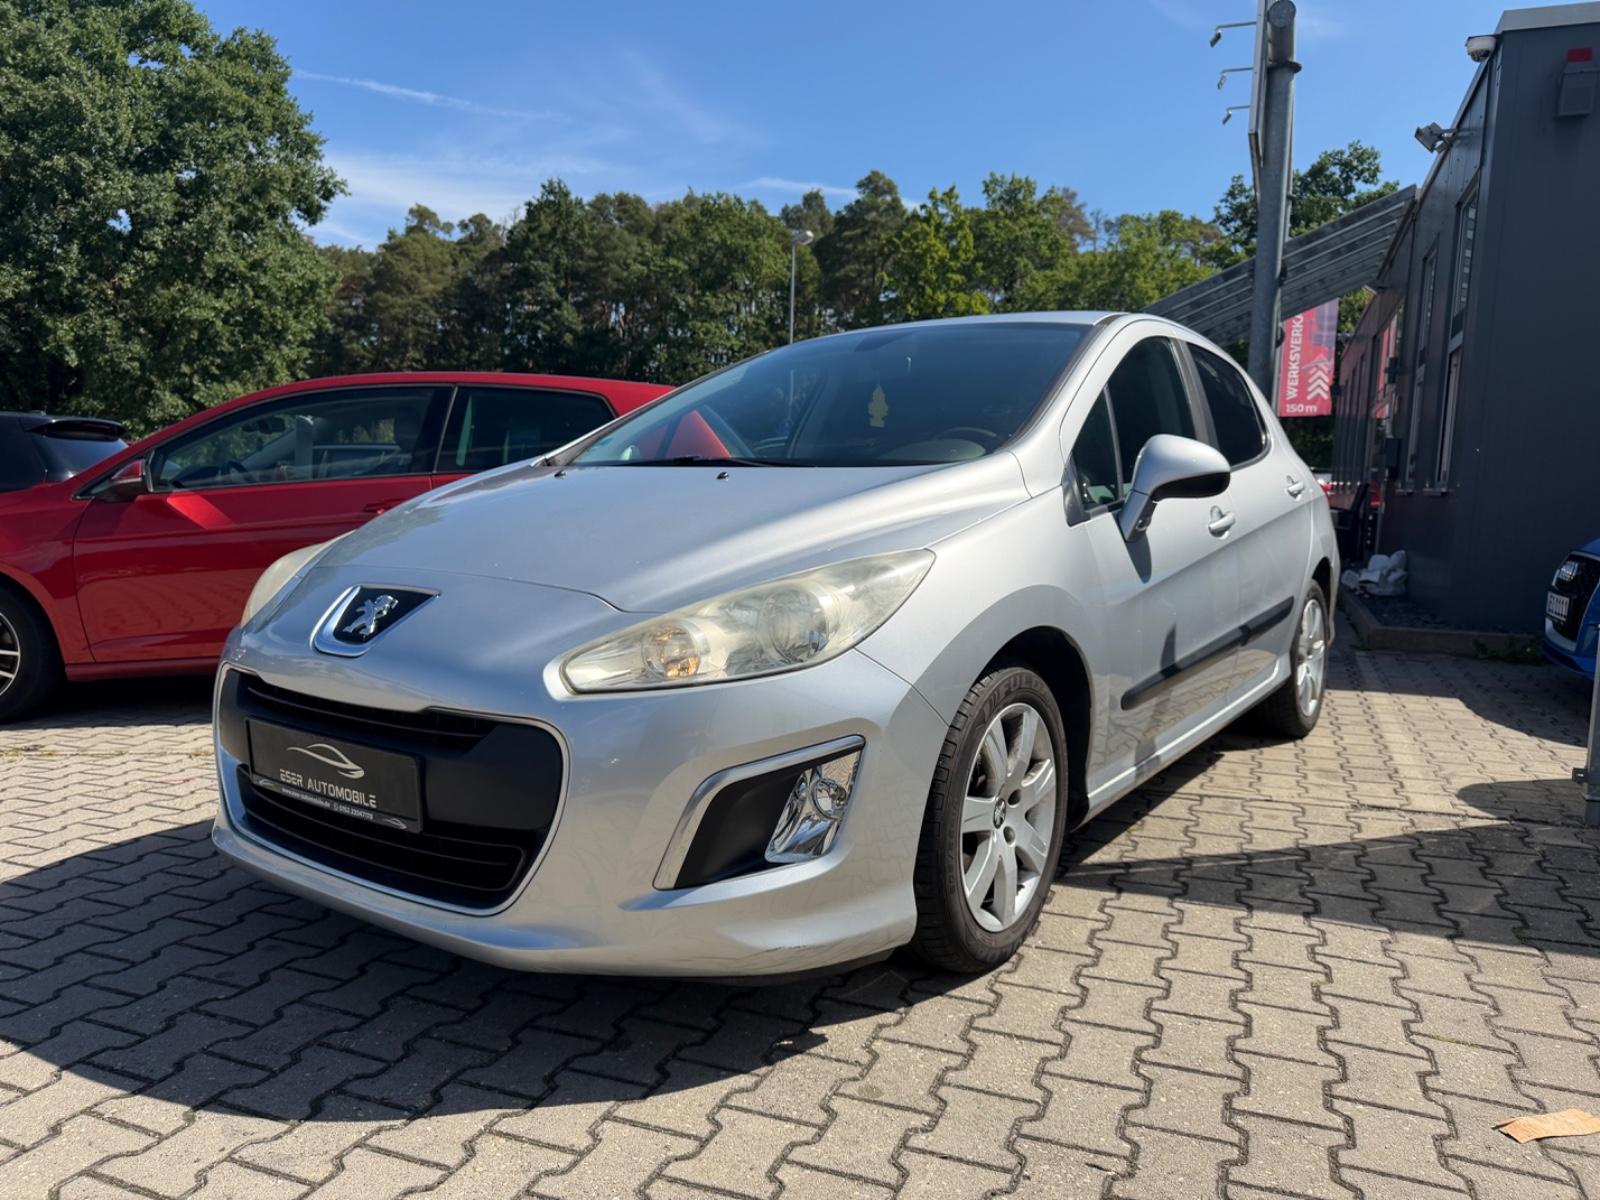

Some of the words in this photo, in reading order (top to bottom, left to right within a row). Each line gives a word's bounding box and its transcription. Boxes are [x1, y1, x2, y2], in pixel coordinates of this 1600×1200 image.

[1286, 403, 1304, 413] 150
[1305, 404, 1318, 413] m
[280, 768, 304, 788] ESER
[307, 777, 377, 808] AUTOMOBILE
